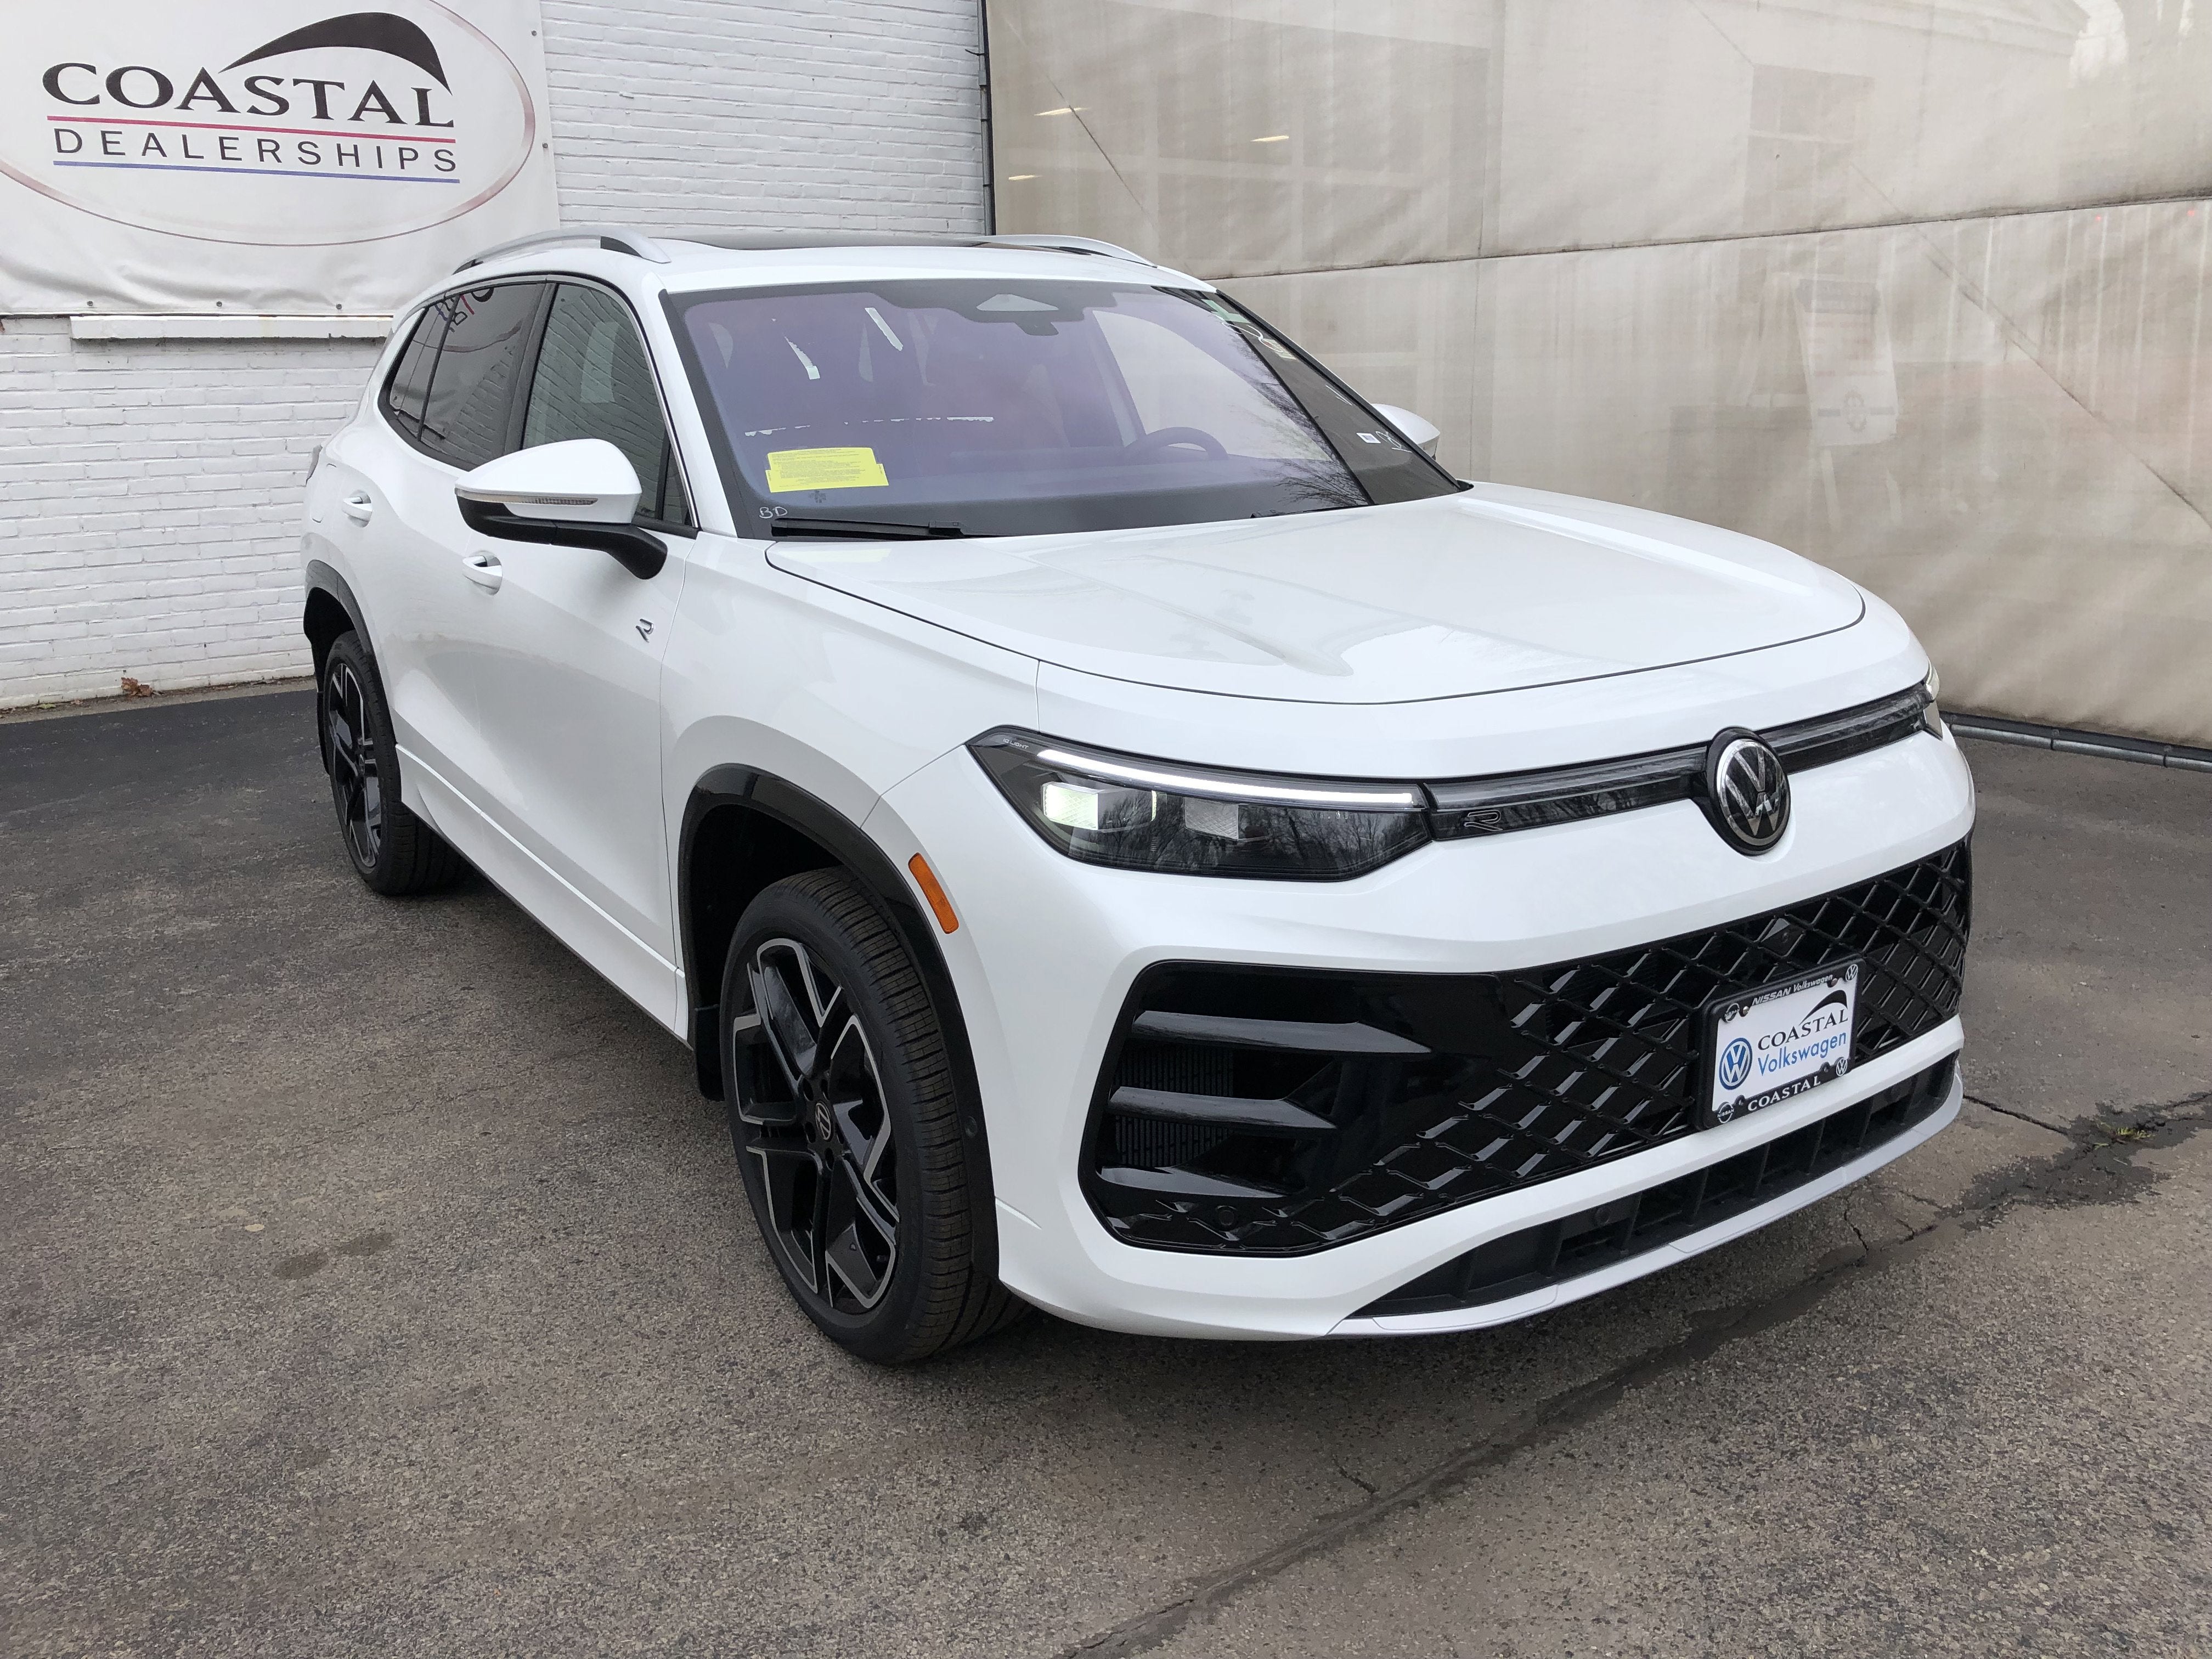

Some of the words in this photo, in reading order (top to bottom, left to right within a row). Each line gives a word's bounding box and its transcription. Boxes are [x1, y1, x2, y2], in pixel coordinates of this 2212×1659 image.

[42, 63, 454, 128] COASTAL
[54, 128, 456, 172] DEALERSHIPS
[1752, 987, 1791, 1006] NISSAN
[1793, 974, 1833, 993] Volkswagen
[1757, 1009, 1848, 1051] COASTAL
[1757, 1032, 1846, 1076] Volkswagen
[1747, 1075, 1821, 1111] COASTAL
